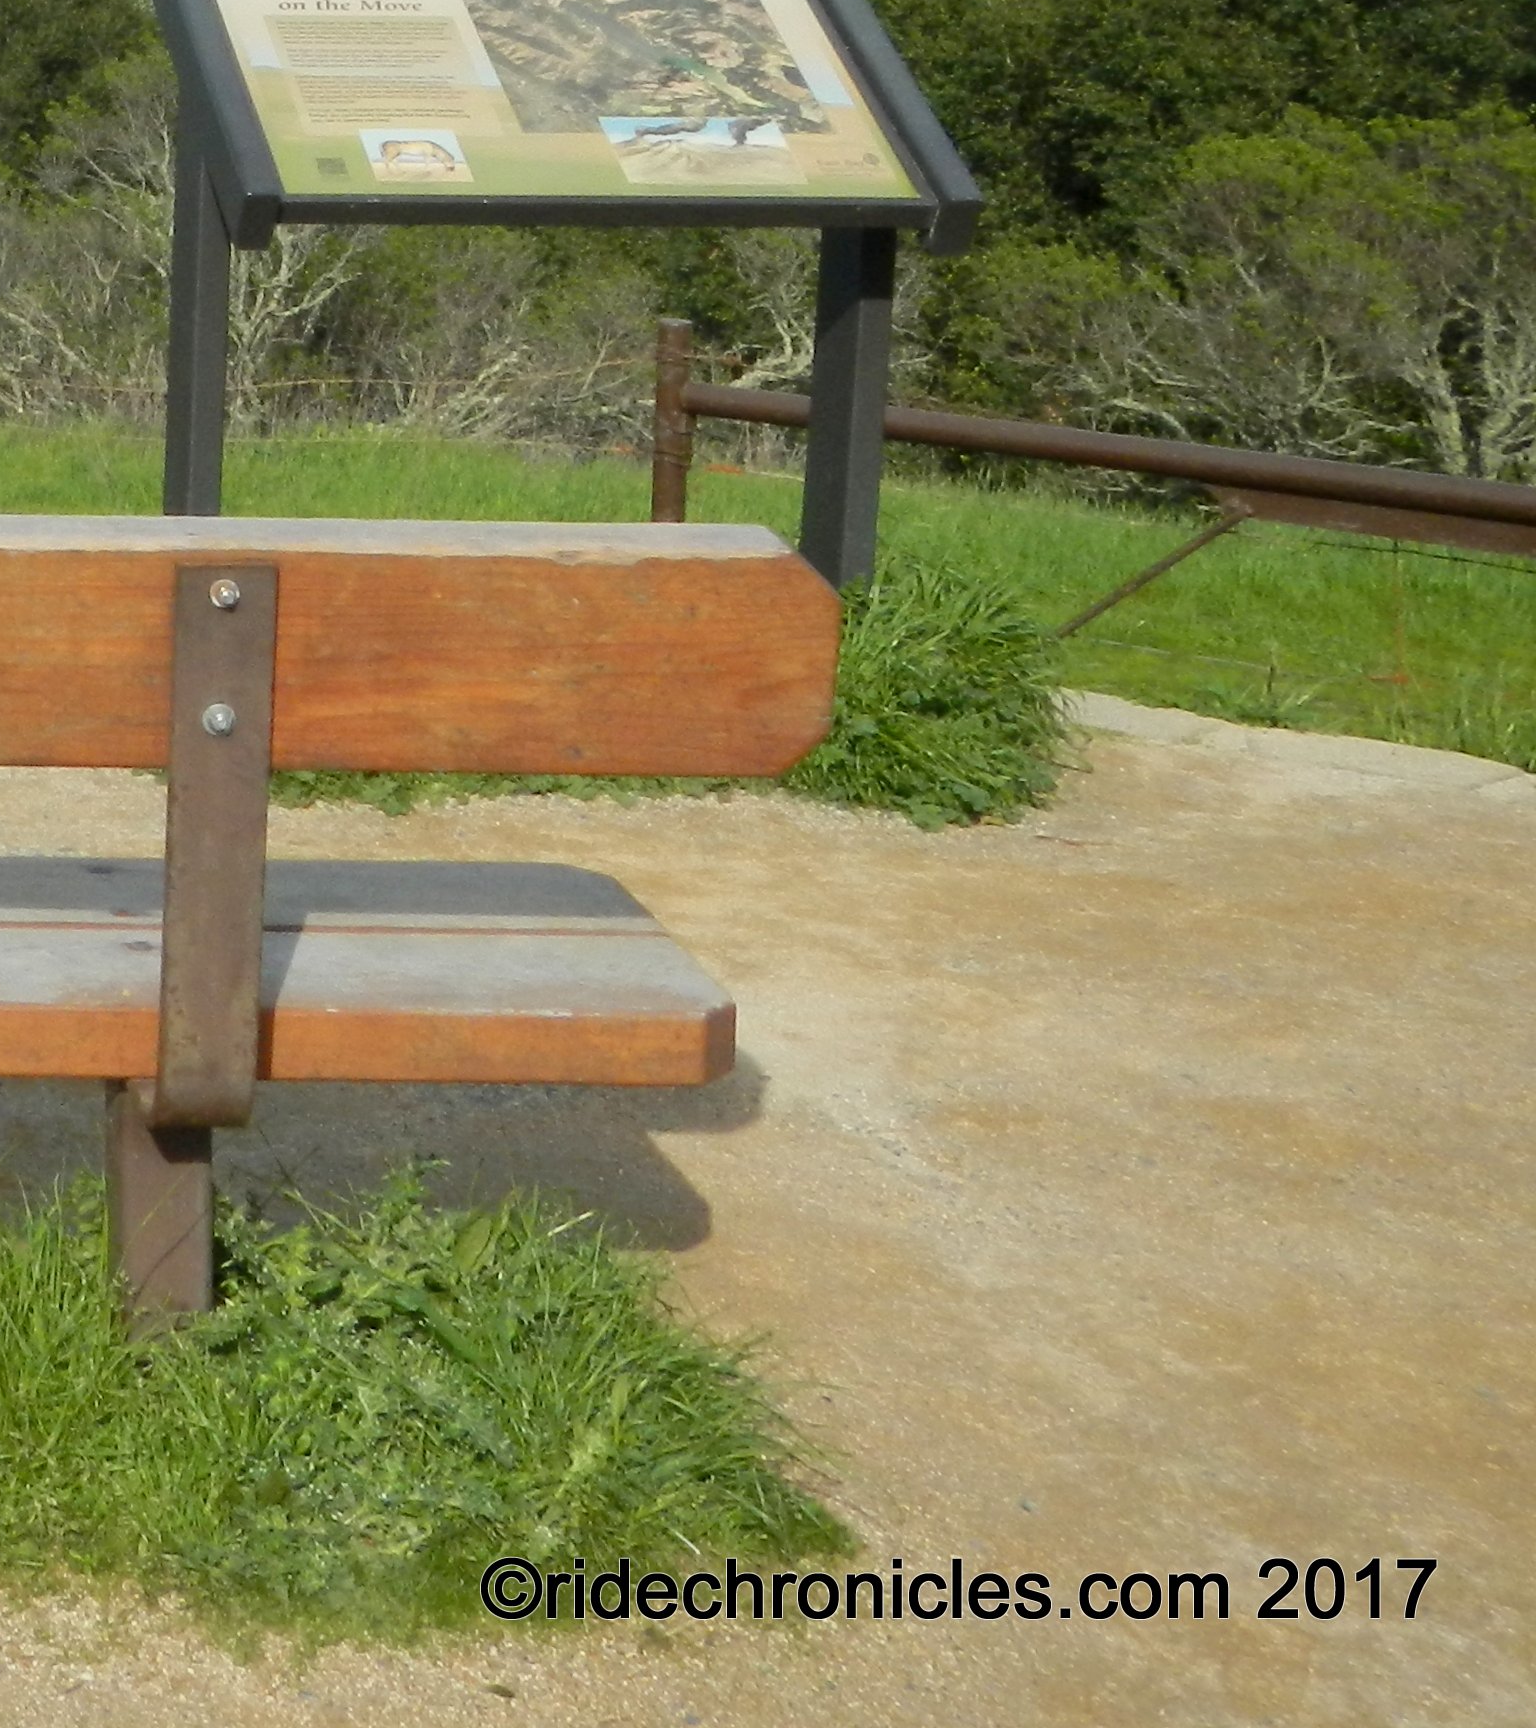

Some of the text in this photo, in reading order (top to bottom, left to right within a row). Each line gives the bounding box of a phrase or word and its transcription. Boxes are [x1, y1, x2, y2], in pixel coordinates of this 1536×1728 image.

[278, 0, 423, 12] on the Move
